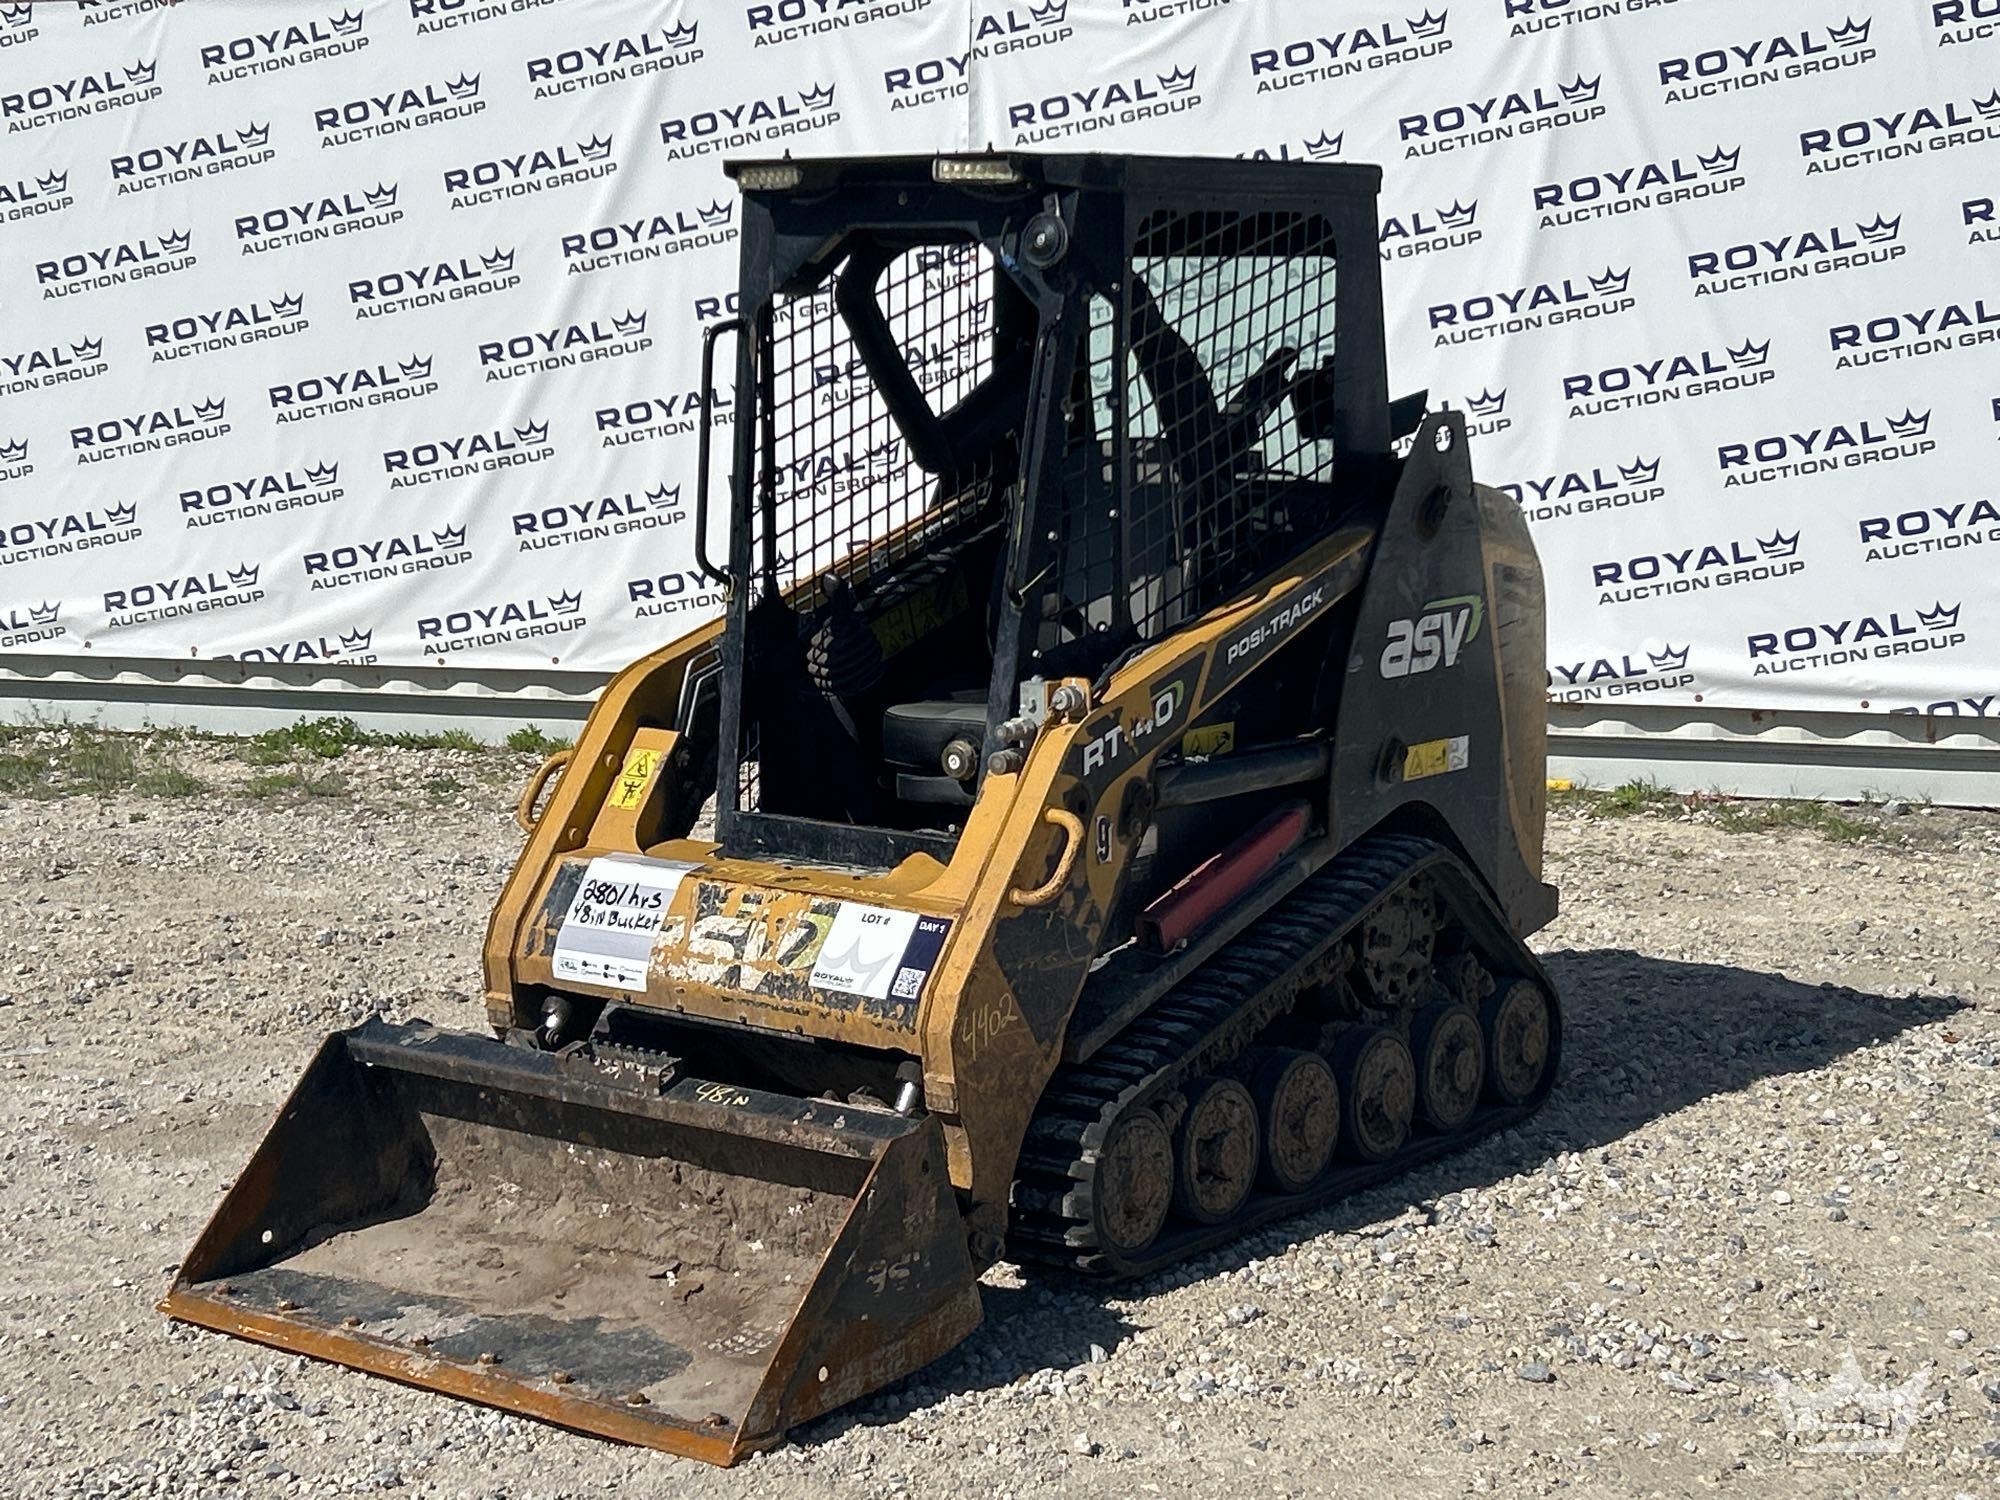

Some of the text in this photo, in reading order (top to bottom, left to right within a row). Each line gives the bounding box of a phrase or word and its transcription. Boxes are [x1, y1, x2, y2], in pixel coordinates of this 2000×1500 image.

[417, 3, 507, 36] AUCTION
[755, 15, 849, 48] AUCTION
[994, 27, 1073, 55] GROUP
[1510, 2, 1620, 37] AUCTION
[201, 22, 331, 68] ROYAL
[208, 37, 369, 85] AUCTION GROUP
[527, 33, 663, 82] ROYAL
[1250, 23, 1407, 76] ROYAL
[1257, 40, 1452, 94] AUCTION GROUP
[1659, 31, 1827, 85] ROYAL
[1, 72, 125, 117] ROYAL
[534, 49, 703, 100] AUCTION GROUP
[885, 52, 970, 93] ROY
[1665, 49, 1876, 104] AUCTION GROUP
[9, 87, 162, 134] AUCTION GROUP
[315, 85, 447, 131] ROYAL
[891, 83, 969, 111] AUCTIO
[1009, 79, 1157, 128] ROYAL
[1399, 88, 1559, 141] ROYAL
[322, 101, 486, 148] AUCTION GROUP
[660, 96, 799, 144] ROYAL
[668, 112, 840, 161] AUCTION GROUP
[1016, 96, 1201, 146] AUCTION GROUP
[1405, 106, 1605, 159] AUCTION GROUP
[1800, 103, 1972, 156] ROYAL
[111, 134, 237, 179] ROYAL
[118, 150, 275, 195] AUCTION GROUP
[444, 146, 579, 193] ROYAL
[1806, 127, 2000, 175] AUCTION GROU
[451, 163, 617, 210] AUCTION GROUP
[1533, 159, 1697, 210] ROYAL
[1539, 177, 1745, 229] AUCTION GROUP
[9, 197, 73, 220] GROUP
[235, 194, 365, 239] ROYAL
[242, 210, 403, 256] AUCTION GROUP
[562, 212, 698, 258] ROYAL
[568, 229, 738, 275] AUCTION GROUP
[1398, 230, 1482, 258] GROUP
[1688, 227, 1857, 278] ROYAL
[36, 241, 160, 284] ROYAL
[43, 257, 196, 300] AUCTION GROUP
[349, 259, 481, 303] ROYAL
[1695, 246, 1906, 297] AUCTION GROUP
[356, 276, 520, 320] AUCTION GROUP
[1428, 280, 1588, 329] ROYAL
[145, 304, 271, 346] ROYAL
[152, 320, 309, 363] AUCTION GROUP
[479, 321, 613, 365] ROYAL
[1435, 298, 1635, 348] AUCTION GROUP
[1830, 301, 2000, 351] ROYAL
[1, 347, 72, 375] YAL
[43, 363, 108, 386] GROUP
[486, 339, 652, 382] AUCTION GROUP
[1563, 351, 1727, 400] ROYAL
[1836, 337, 1952, 370] AUCTION
[269, 366, 400, 408] ROYAL
[276, 382, 438, 424] AUCTION GROUP
[1569, 370, 1775, 418] AUCTION GROUP
[70, 408, 194, 449] ROYAL
[78, 424, 231, 465] AUCTION GROUP
[603, 420, 694, 448] AUCTION
[1718, 421, 1887, 469] ROYAL
[383, 431, 516, 472] ROYAL
[391, 448, 554, 489] AUCTION GROUP
[1724, 440, 1935, 488] AUCTION GROUP
[179, 472, 307, 512] ROYAL
[187, 489, 344, 529] AUCTION GROUP
[1578, 488, 1665, 512] GROUP
[512, 494, 646, 535] ROYAL
[520, 511, 685, 552] AUCTION GROUP
[1859, 500, 2000, 543] ROYA
[2, 528, 142, 564] UCTION GROUP
[303, 535, 433, 574] ROYAL
[1593, 542, 1757, 587] ROYAL
[1866, 531, 1982, 562] AUCTION
[104, 573, 228, 612] ROYAL
[311, 551, 472, 591] AUCTION GROUP
[1599, 561, 1804, 605] AUCTION GROUP
[108, 590, 264, 630] AUCTION GROUP
[418, 600, 548, 639] ROYAL
[1227, 587, 1324, 665] POSI-TRACK
[2, 627, 66, 647] GROUP
[424, 618, 586, 656] AUCTION GROUP
[1748, 613, 1916, 658] ROYAL
[1754, 633, 1965, 676] AUCTION GROUP
[1607, 674, 1694, 696] GROUP
[628, 883, 662, 909] hrs
[861, 913, 882, 925] LOT
[919, 921, 938, 933] DAY
